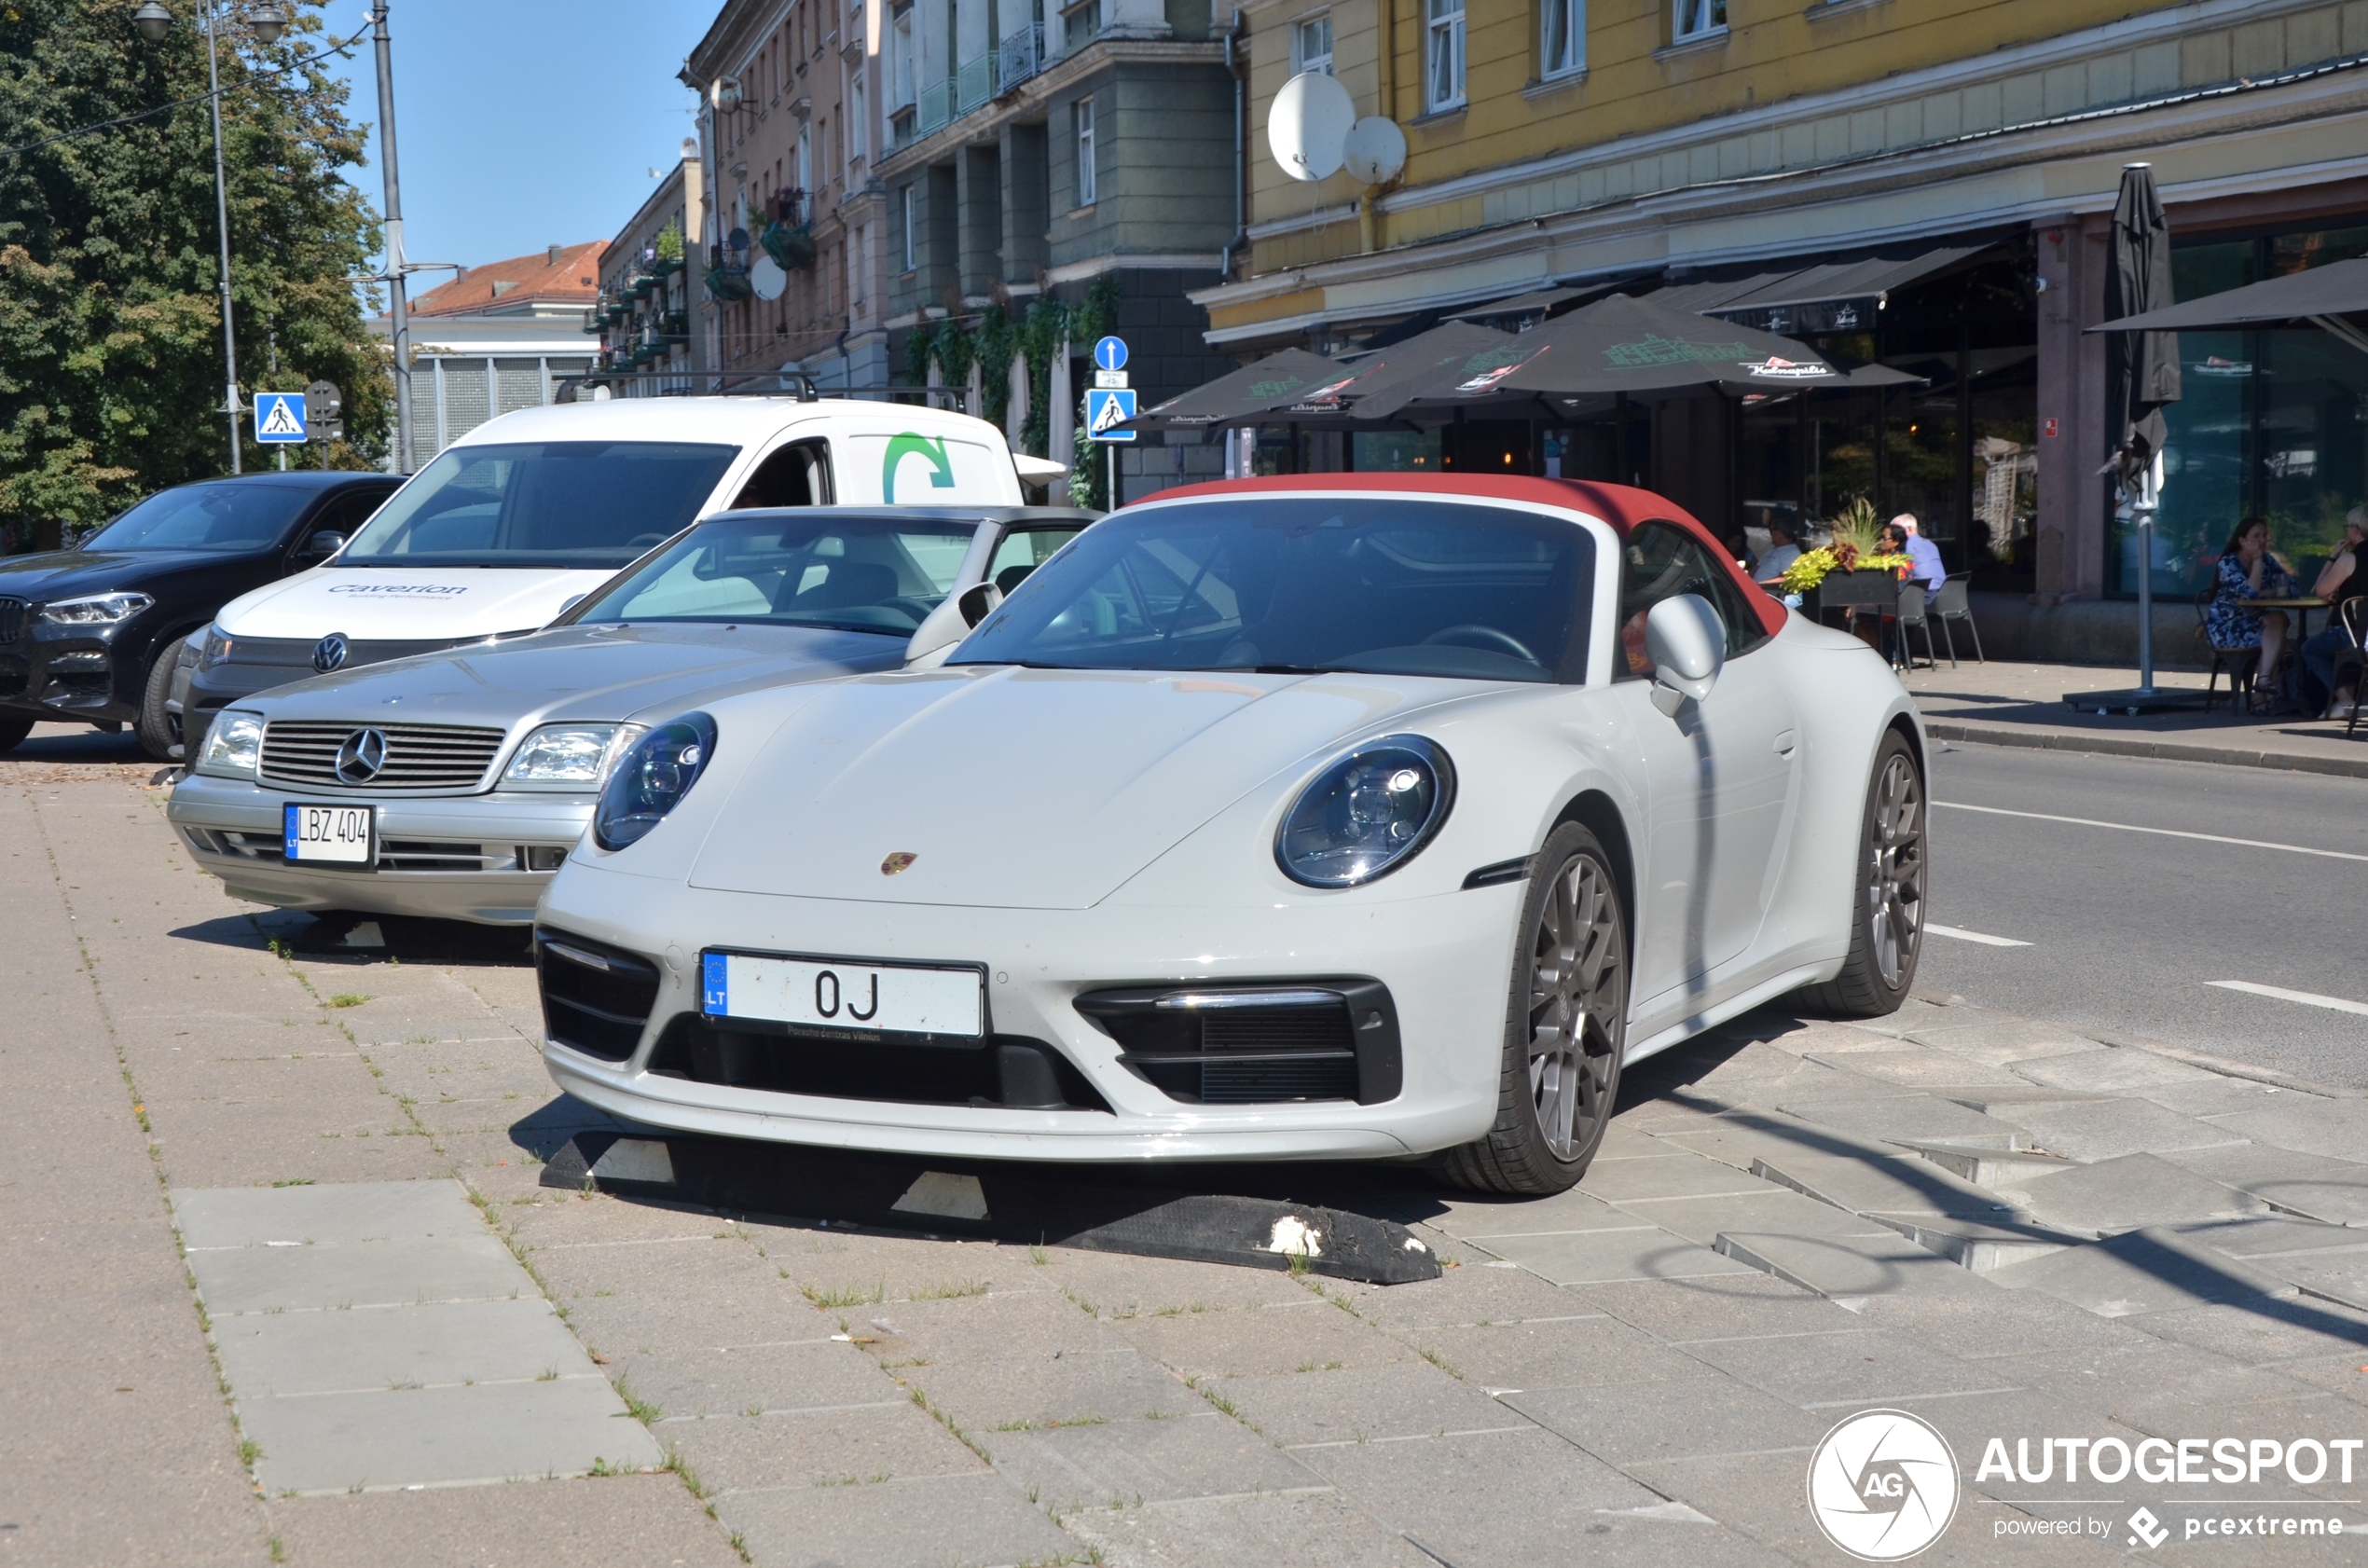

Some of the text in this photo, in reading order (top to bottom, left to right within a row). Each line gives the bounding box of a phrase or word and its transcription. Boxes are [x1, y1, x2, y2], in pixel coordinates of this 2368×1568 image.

[1748, 365, 1827, 377] Kalnapilis
[328, 585, 468, 594] Caverion
[298, 809, 366, 844] LBZ 404
[287, 839, 297, 847] LT
[708, 990, 725, 1005] LT
